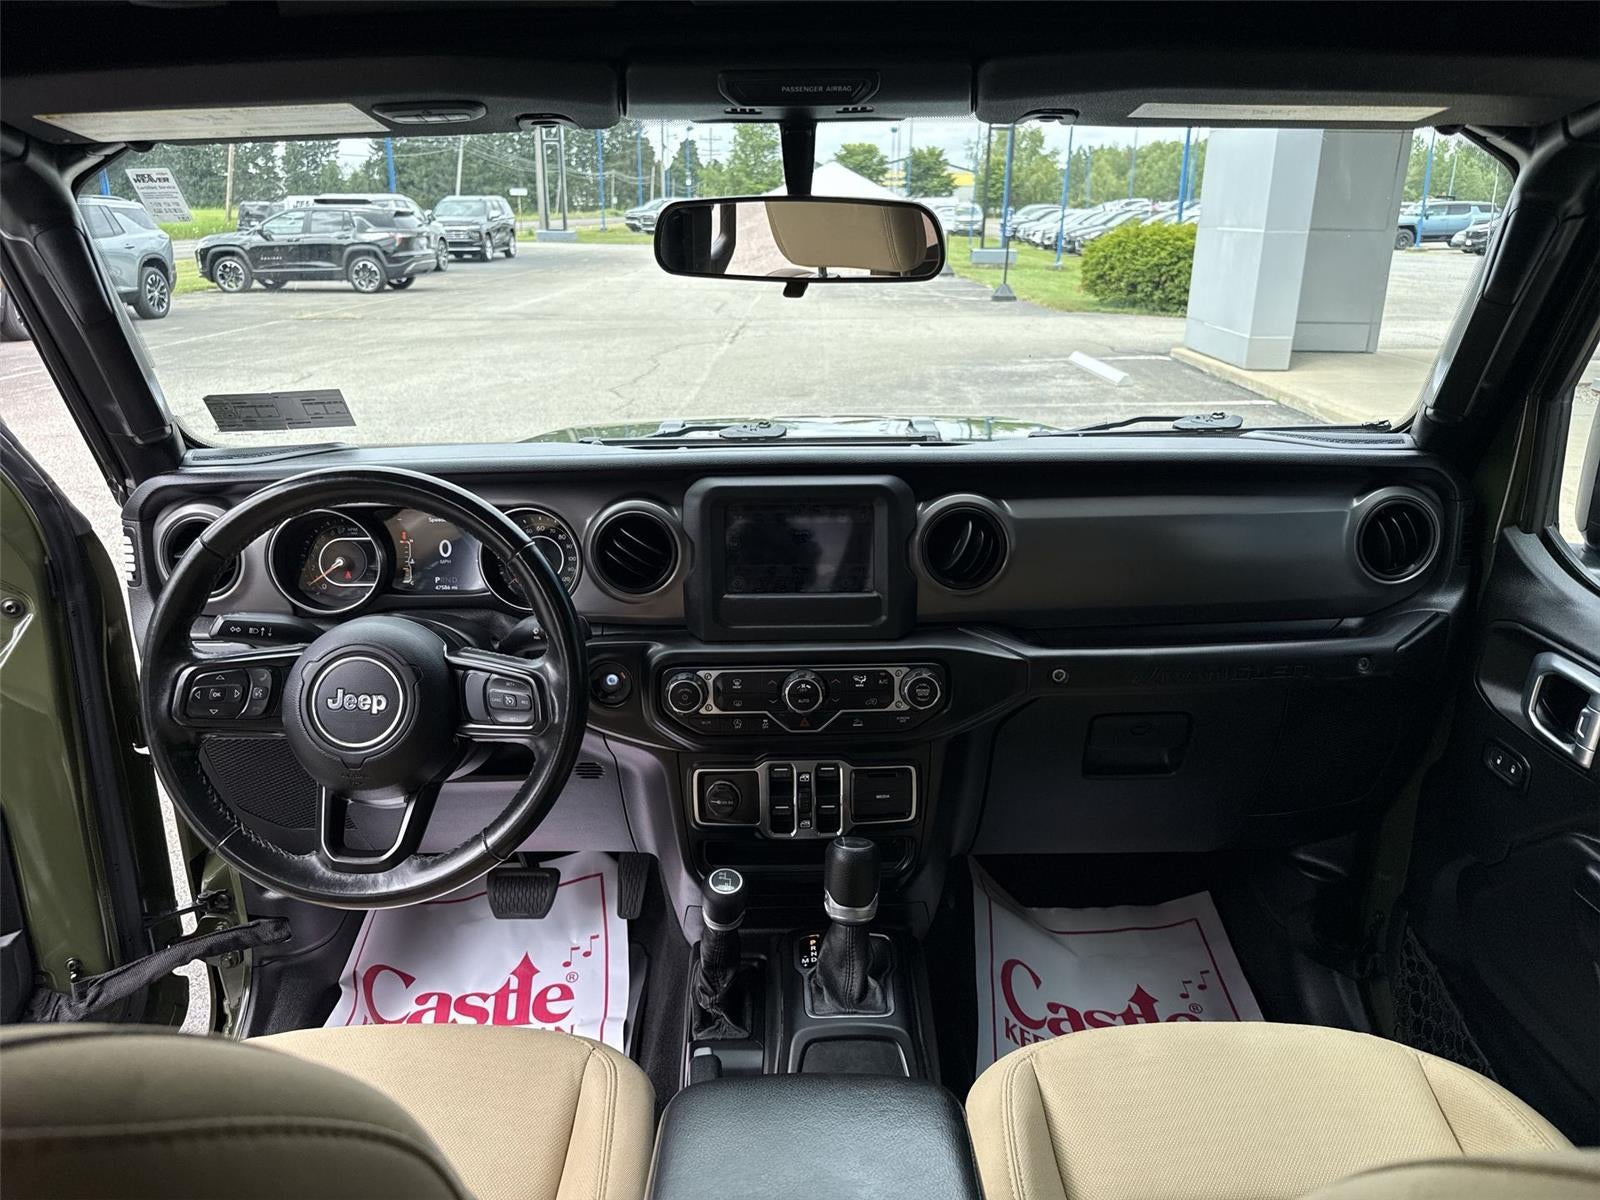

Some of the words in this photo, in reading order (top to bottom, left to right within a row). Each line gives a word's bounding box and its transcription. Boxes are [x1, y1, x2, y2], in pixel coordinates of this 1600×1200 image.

[781, 85, 824, 93] PASSENGER
[825, 85, 852, 93] AIRBAG
[439, 539, 453, 558] 0
[327, 688, 387, 714] Jeep
[362, 951, 575, 1025] Castle
[1001, 958, 1202, 1036] Castl
